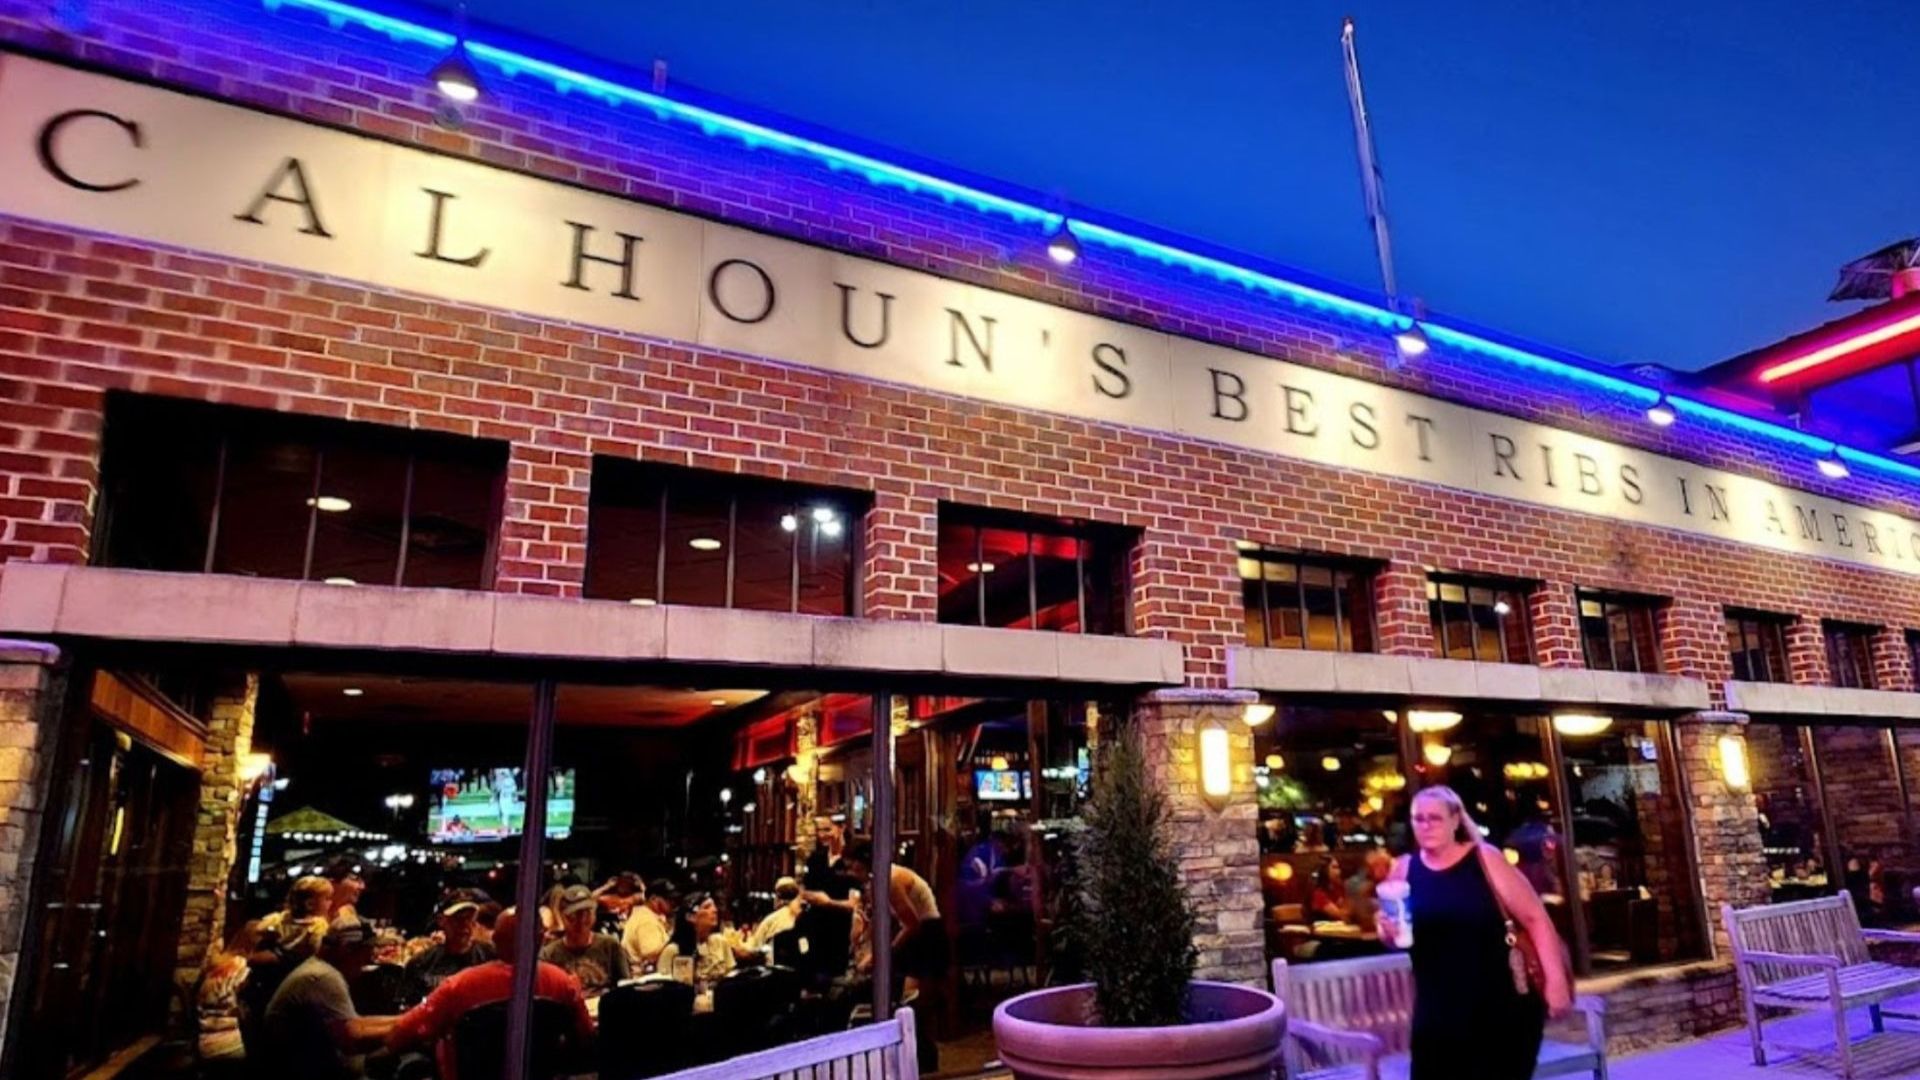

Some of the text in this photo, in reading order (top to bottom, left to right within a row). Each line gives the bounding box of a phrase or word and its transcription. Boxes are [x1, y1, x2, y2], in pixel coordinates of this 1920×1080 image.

[36, 108, 1132, 399] CALHOUN'S
[1207, 368, 1434, 462] BEST
[1488, 432, 1644, 505] RIBS
[1677, 476, 1730, 522] IN
